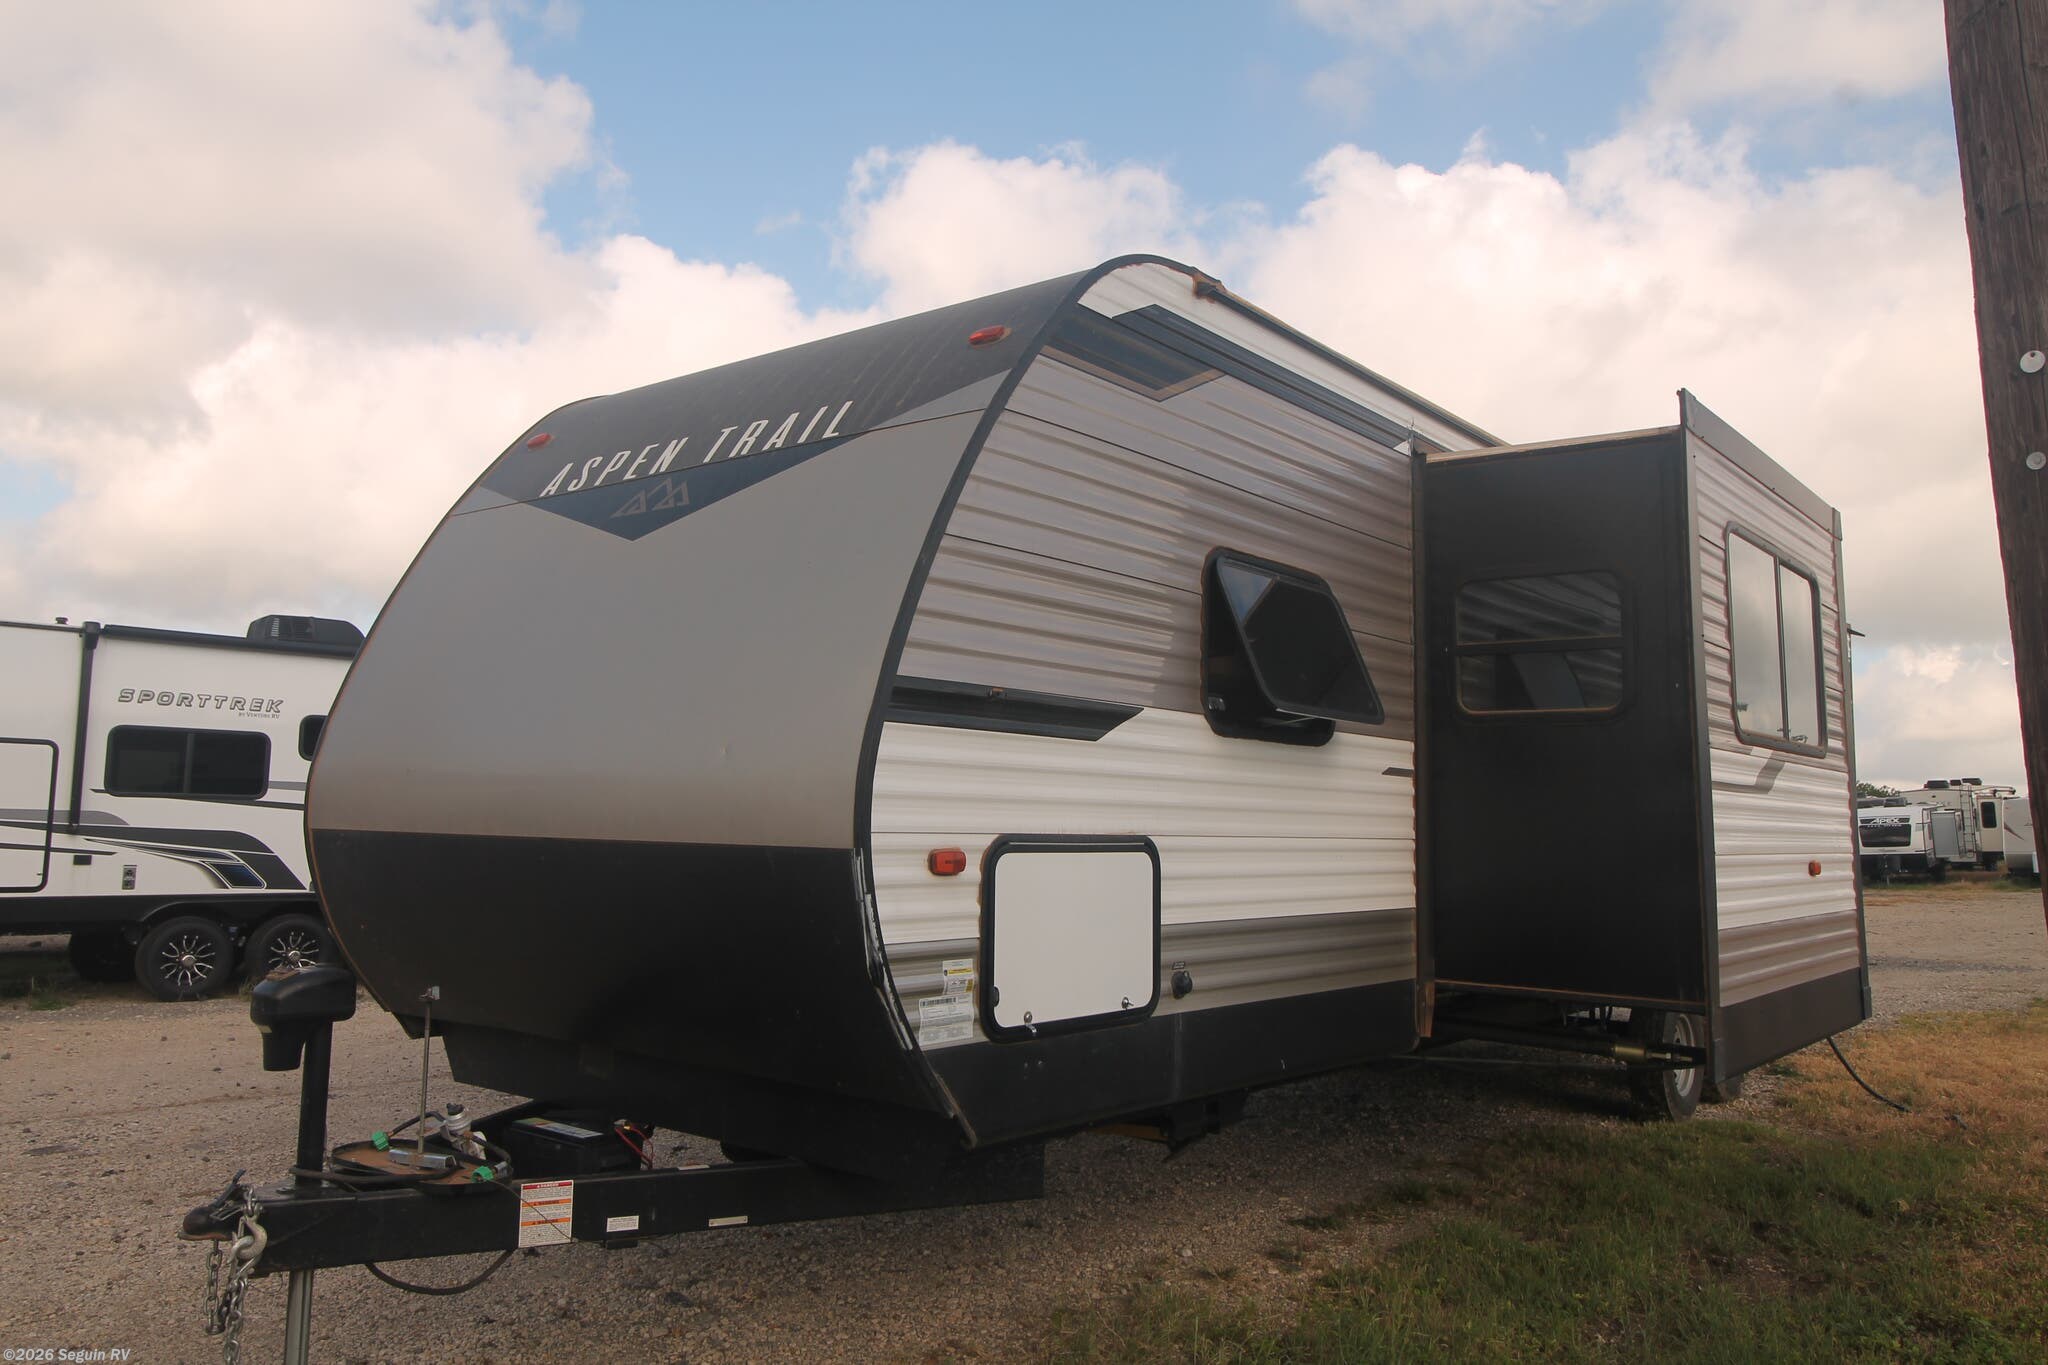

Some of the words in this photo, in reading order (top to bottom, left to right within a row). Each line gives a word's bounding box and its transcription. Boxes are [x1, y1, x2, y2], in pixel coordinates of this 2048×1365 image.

[540, 437, 689, 498] ASPEN
[702, 400, 853, 464] TRAIL
[118, 688, 284, 713] SPORTTREK
